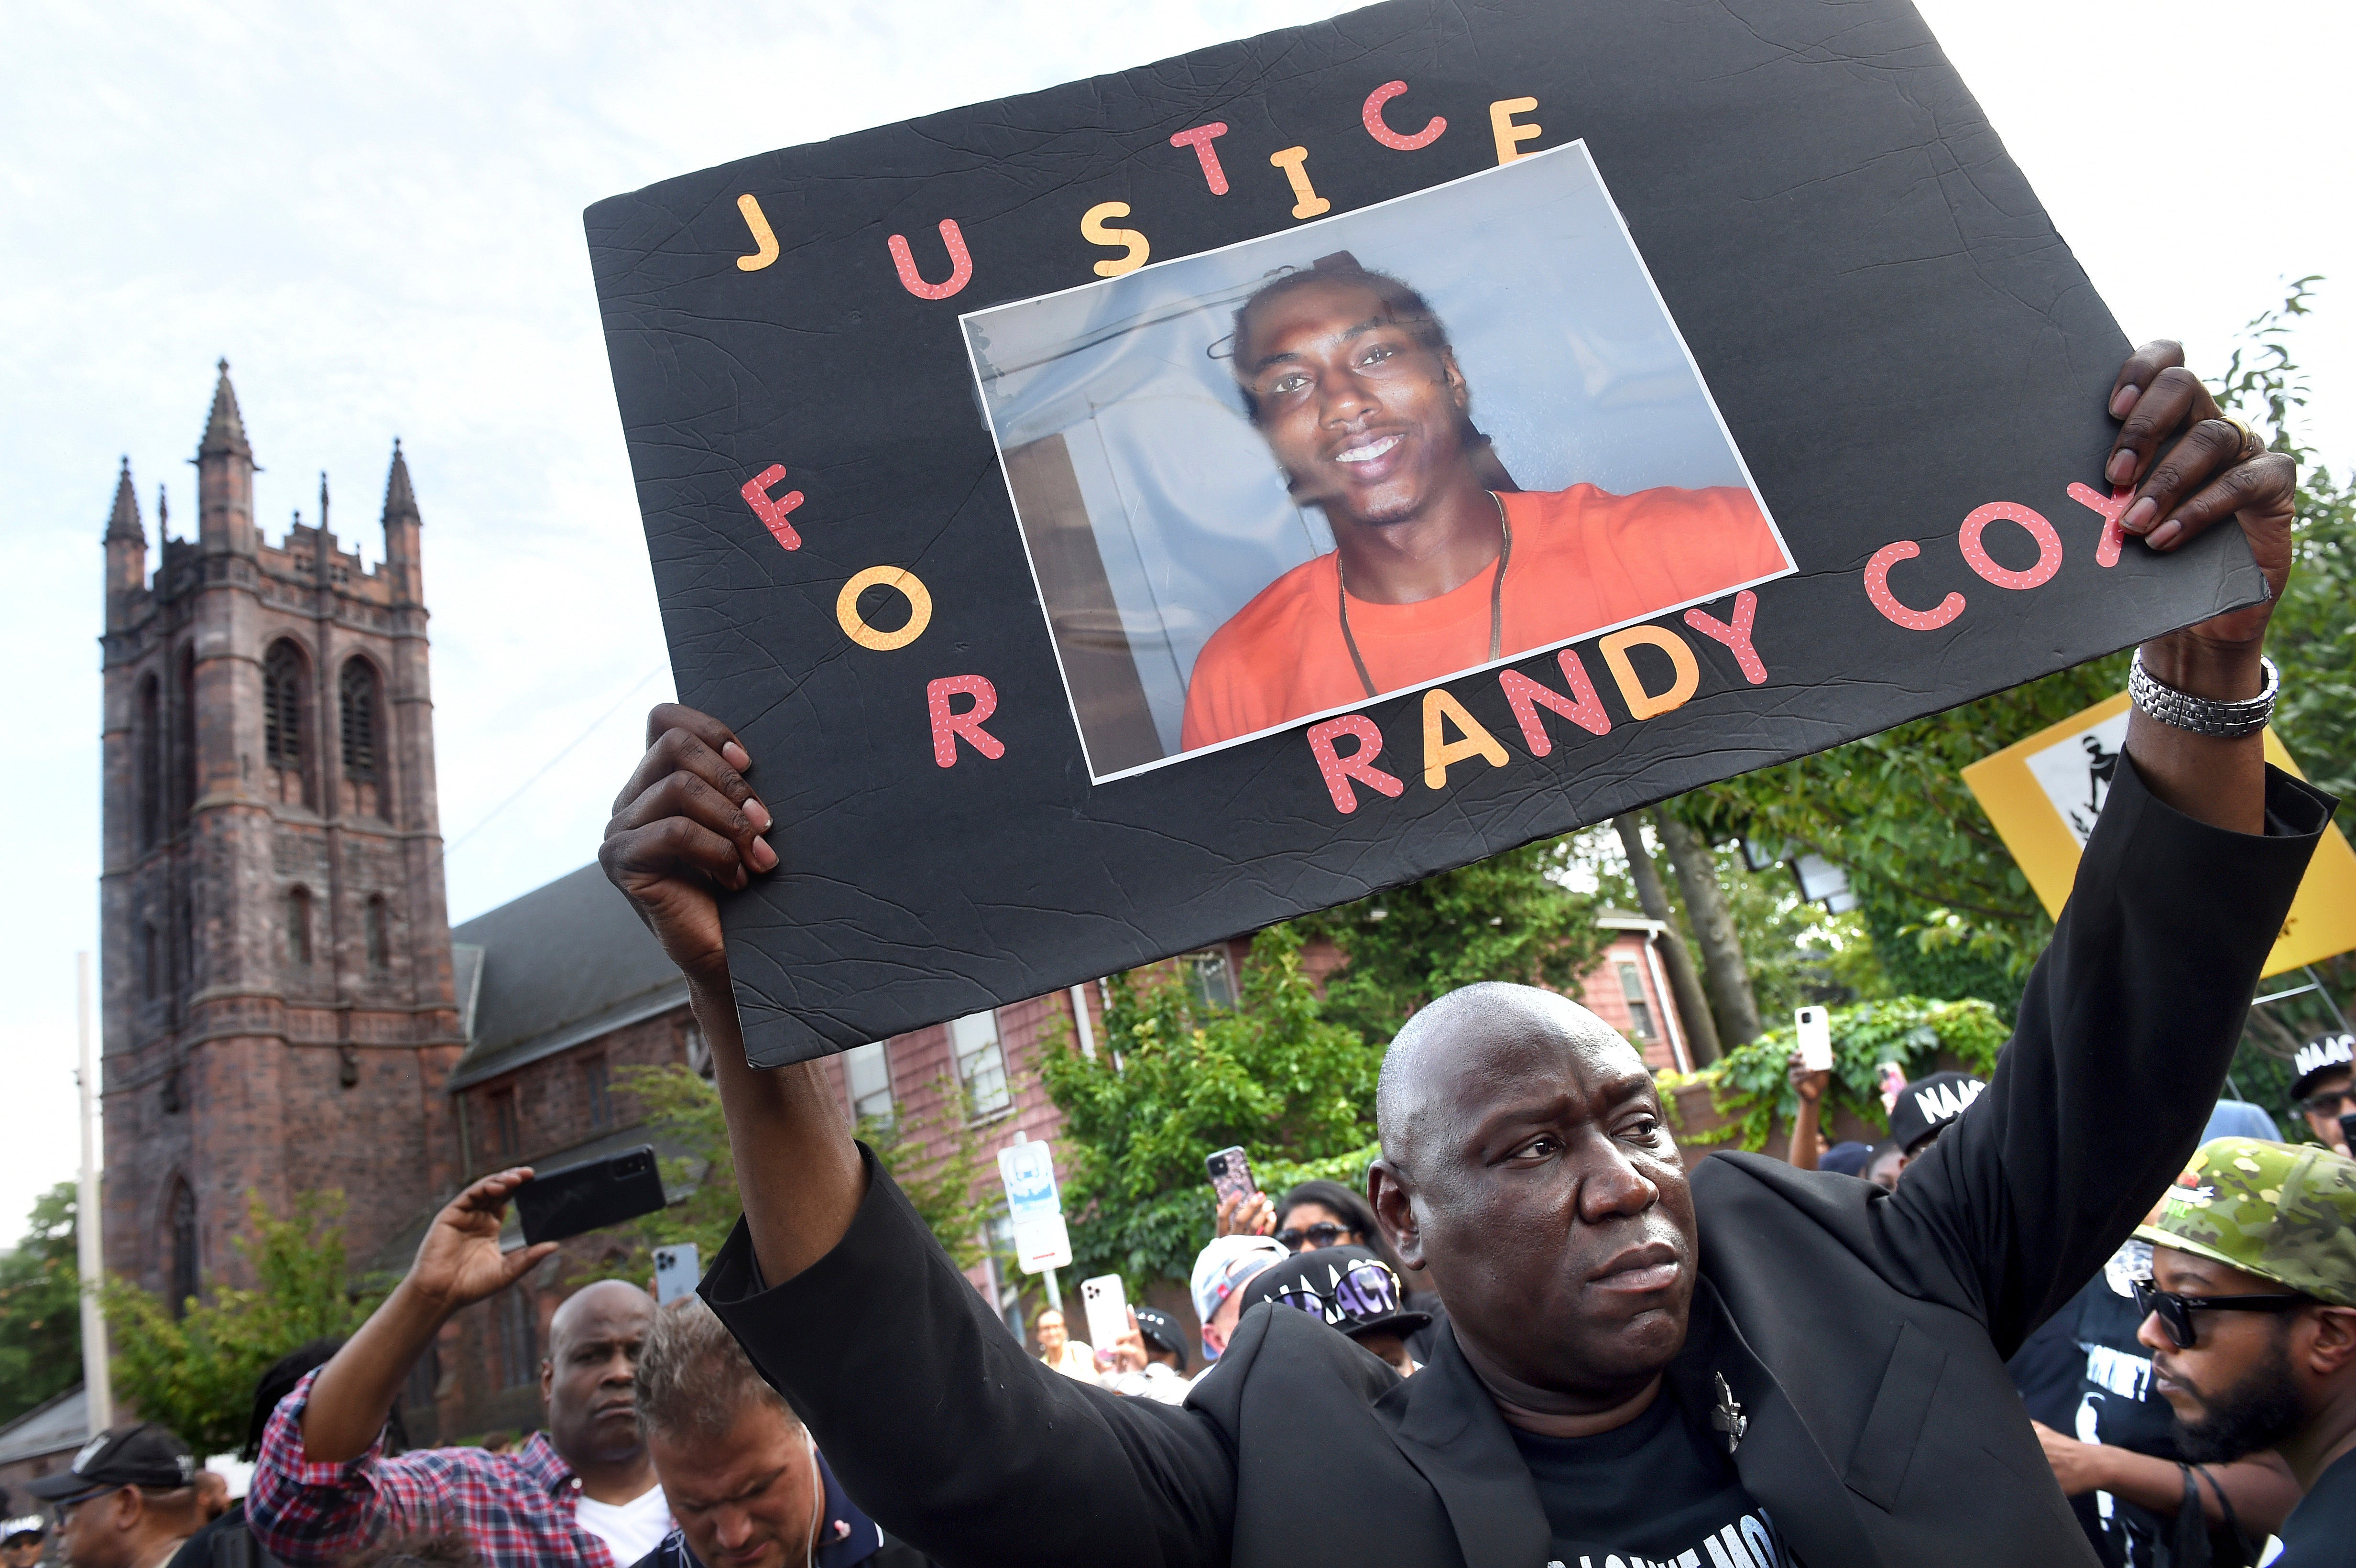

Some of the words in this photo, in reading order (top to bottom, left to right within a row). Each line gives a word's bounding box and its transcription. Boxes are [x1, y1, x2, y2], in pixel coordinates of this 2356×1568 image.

[736, 80, 1543, 300] JUSTICE
[741, 464, 1005, 768] FOR
[1308, 590, 1768, 814] RANDY
[1864, 482, 2137, 631] COX
[2294, 1034, 2355, 1076] NAAC
